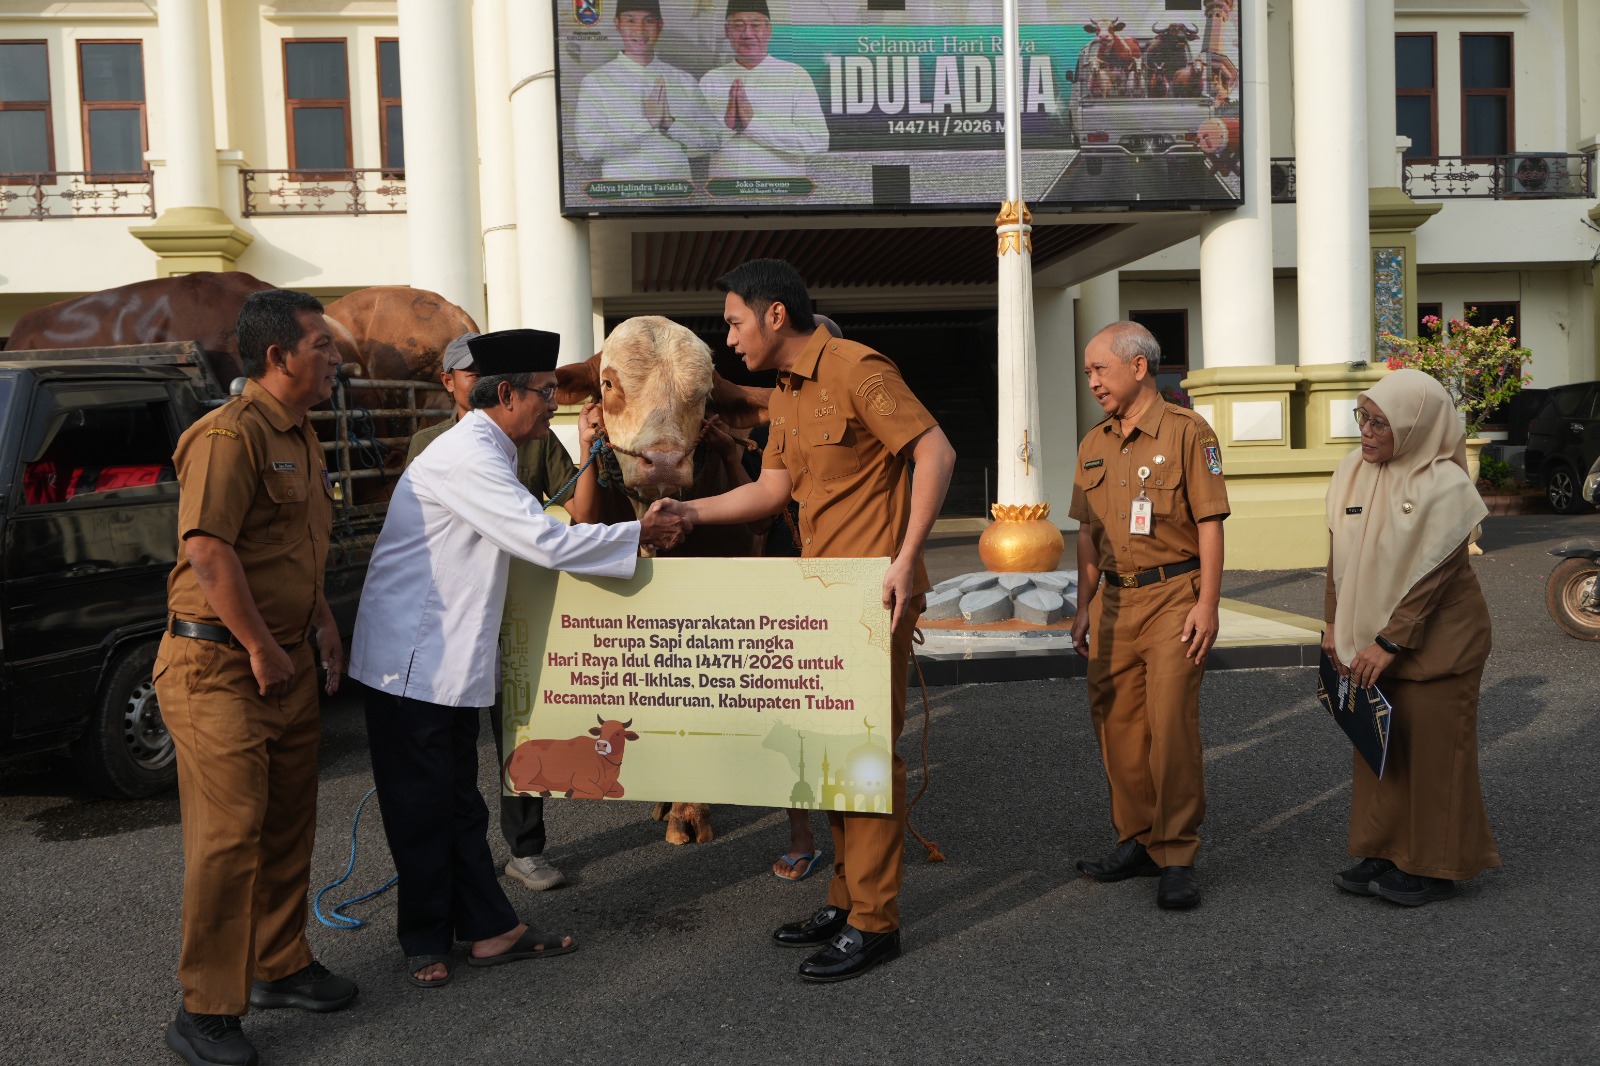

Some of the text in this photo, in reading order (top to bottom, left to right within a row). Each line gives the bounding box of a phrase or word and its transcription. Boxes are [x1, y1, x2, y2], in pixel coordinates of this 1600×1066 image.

[857, 35, 1036, 53] Selamat Hari Ra
[887, 120, 925, 134] 1447
[928, 120, 940, 134] H
[953, 119, 992, 133] 2026
[589, 183, 688, 193] Aditya Halindra Faridzky
[735, 180, 790, 188] Joko Sarwono
[561, 614, 829, 634] Bantuan Kemasyarakatan Presiden
[593, 633, 795, 654] berupa Sapi dalam rangka
[547, 651, 844, 671] Hari Raya Idul Adha 1447H/2026 untuk
[570, 671, 824, 691] Masjid Al-Ikhlas, Desa Sidomukti,
[543, 689, 855, 713] Kecamatan Kenduruan, Kabupaten Tuban
